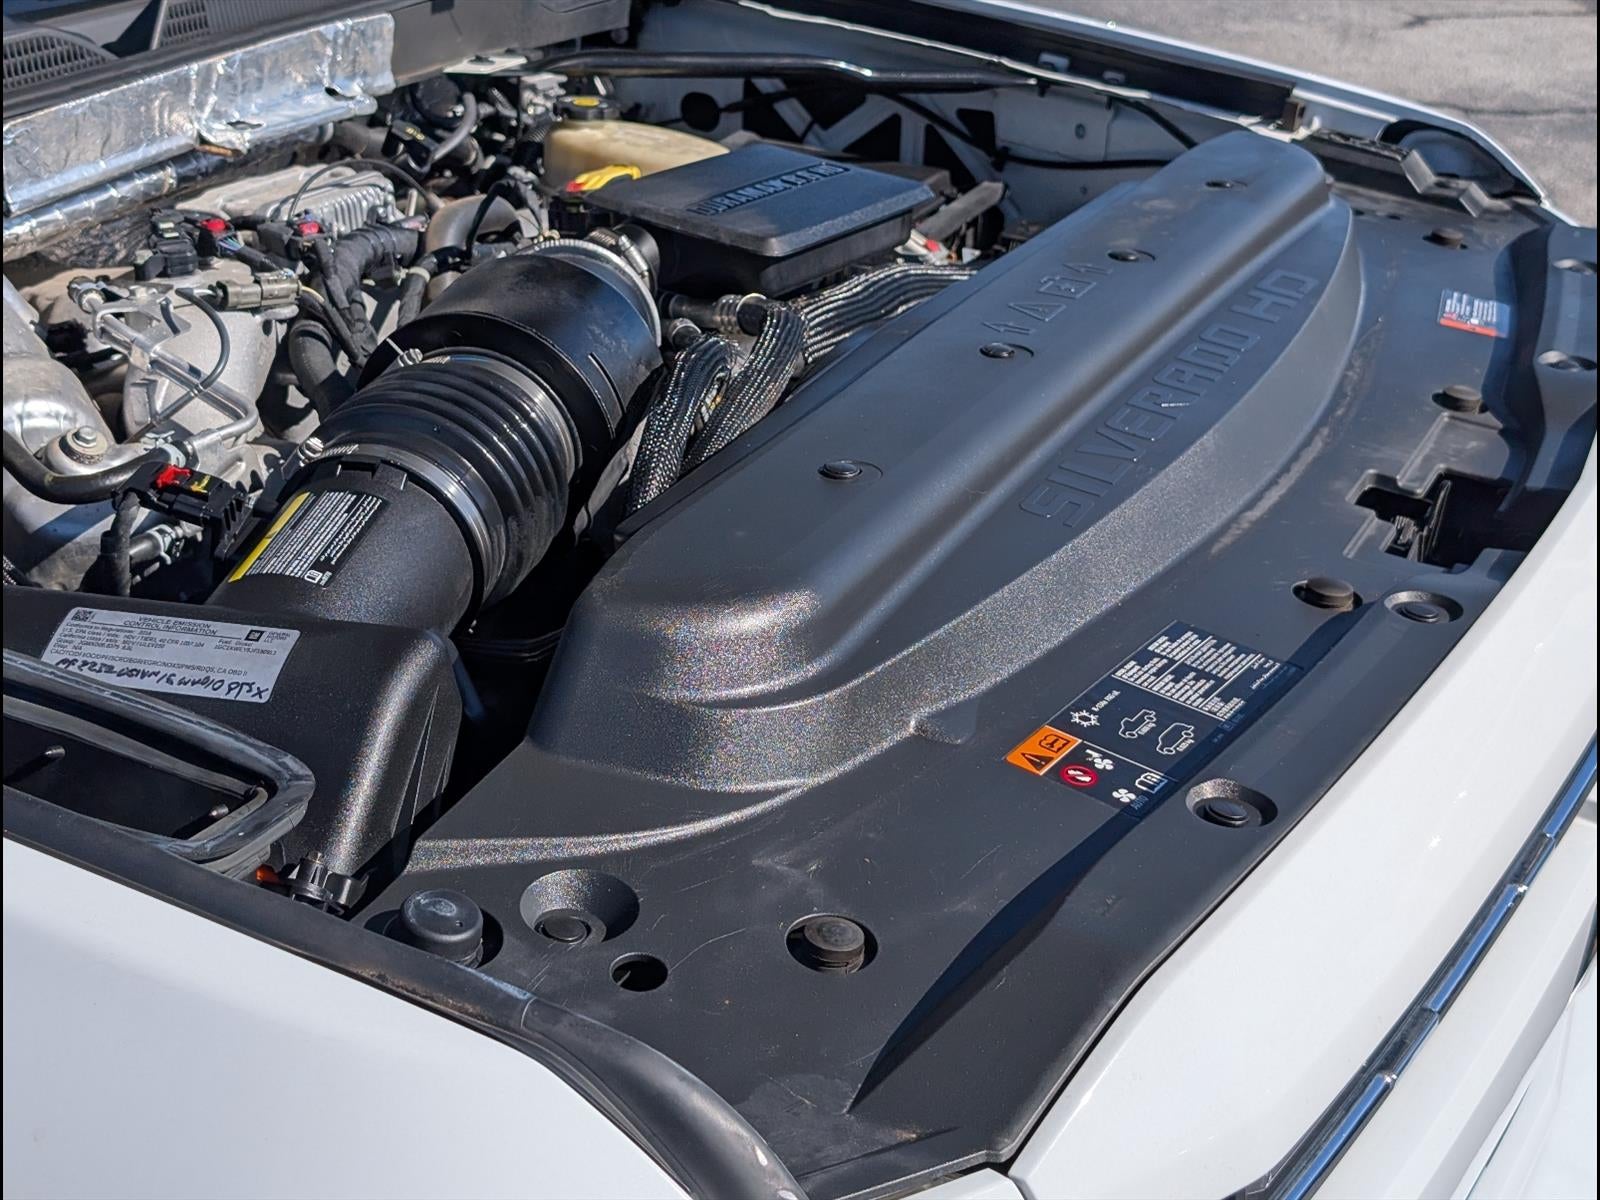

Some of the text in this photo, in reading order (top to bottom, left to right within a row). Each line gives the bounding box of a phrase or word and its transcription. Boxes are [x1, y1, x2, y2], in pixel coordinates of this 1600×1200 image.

[686, 178, 792, 216] DURAMAX
[1019, 269, 1320, 528] SILVERADO HD
[123, 620, 218, 635] CONTROL INFORMATION
[138, 616, 211, 629] VEHICLE EMISSION
